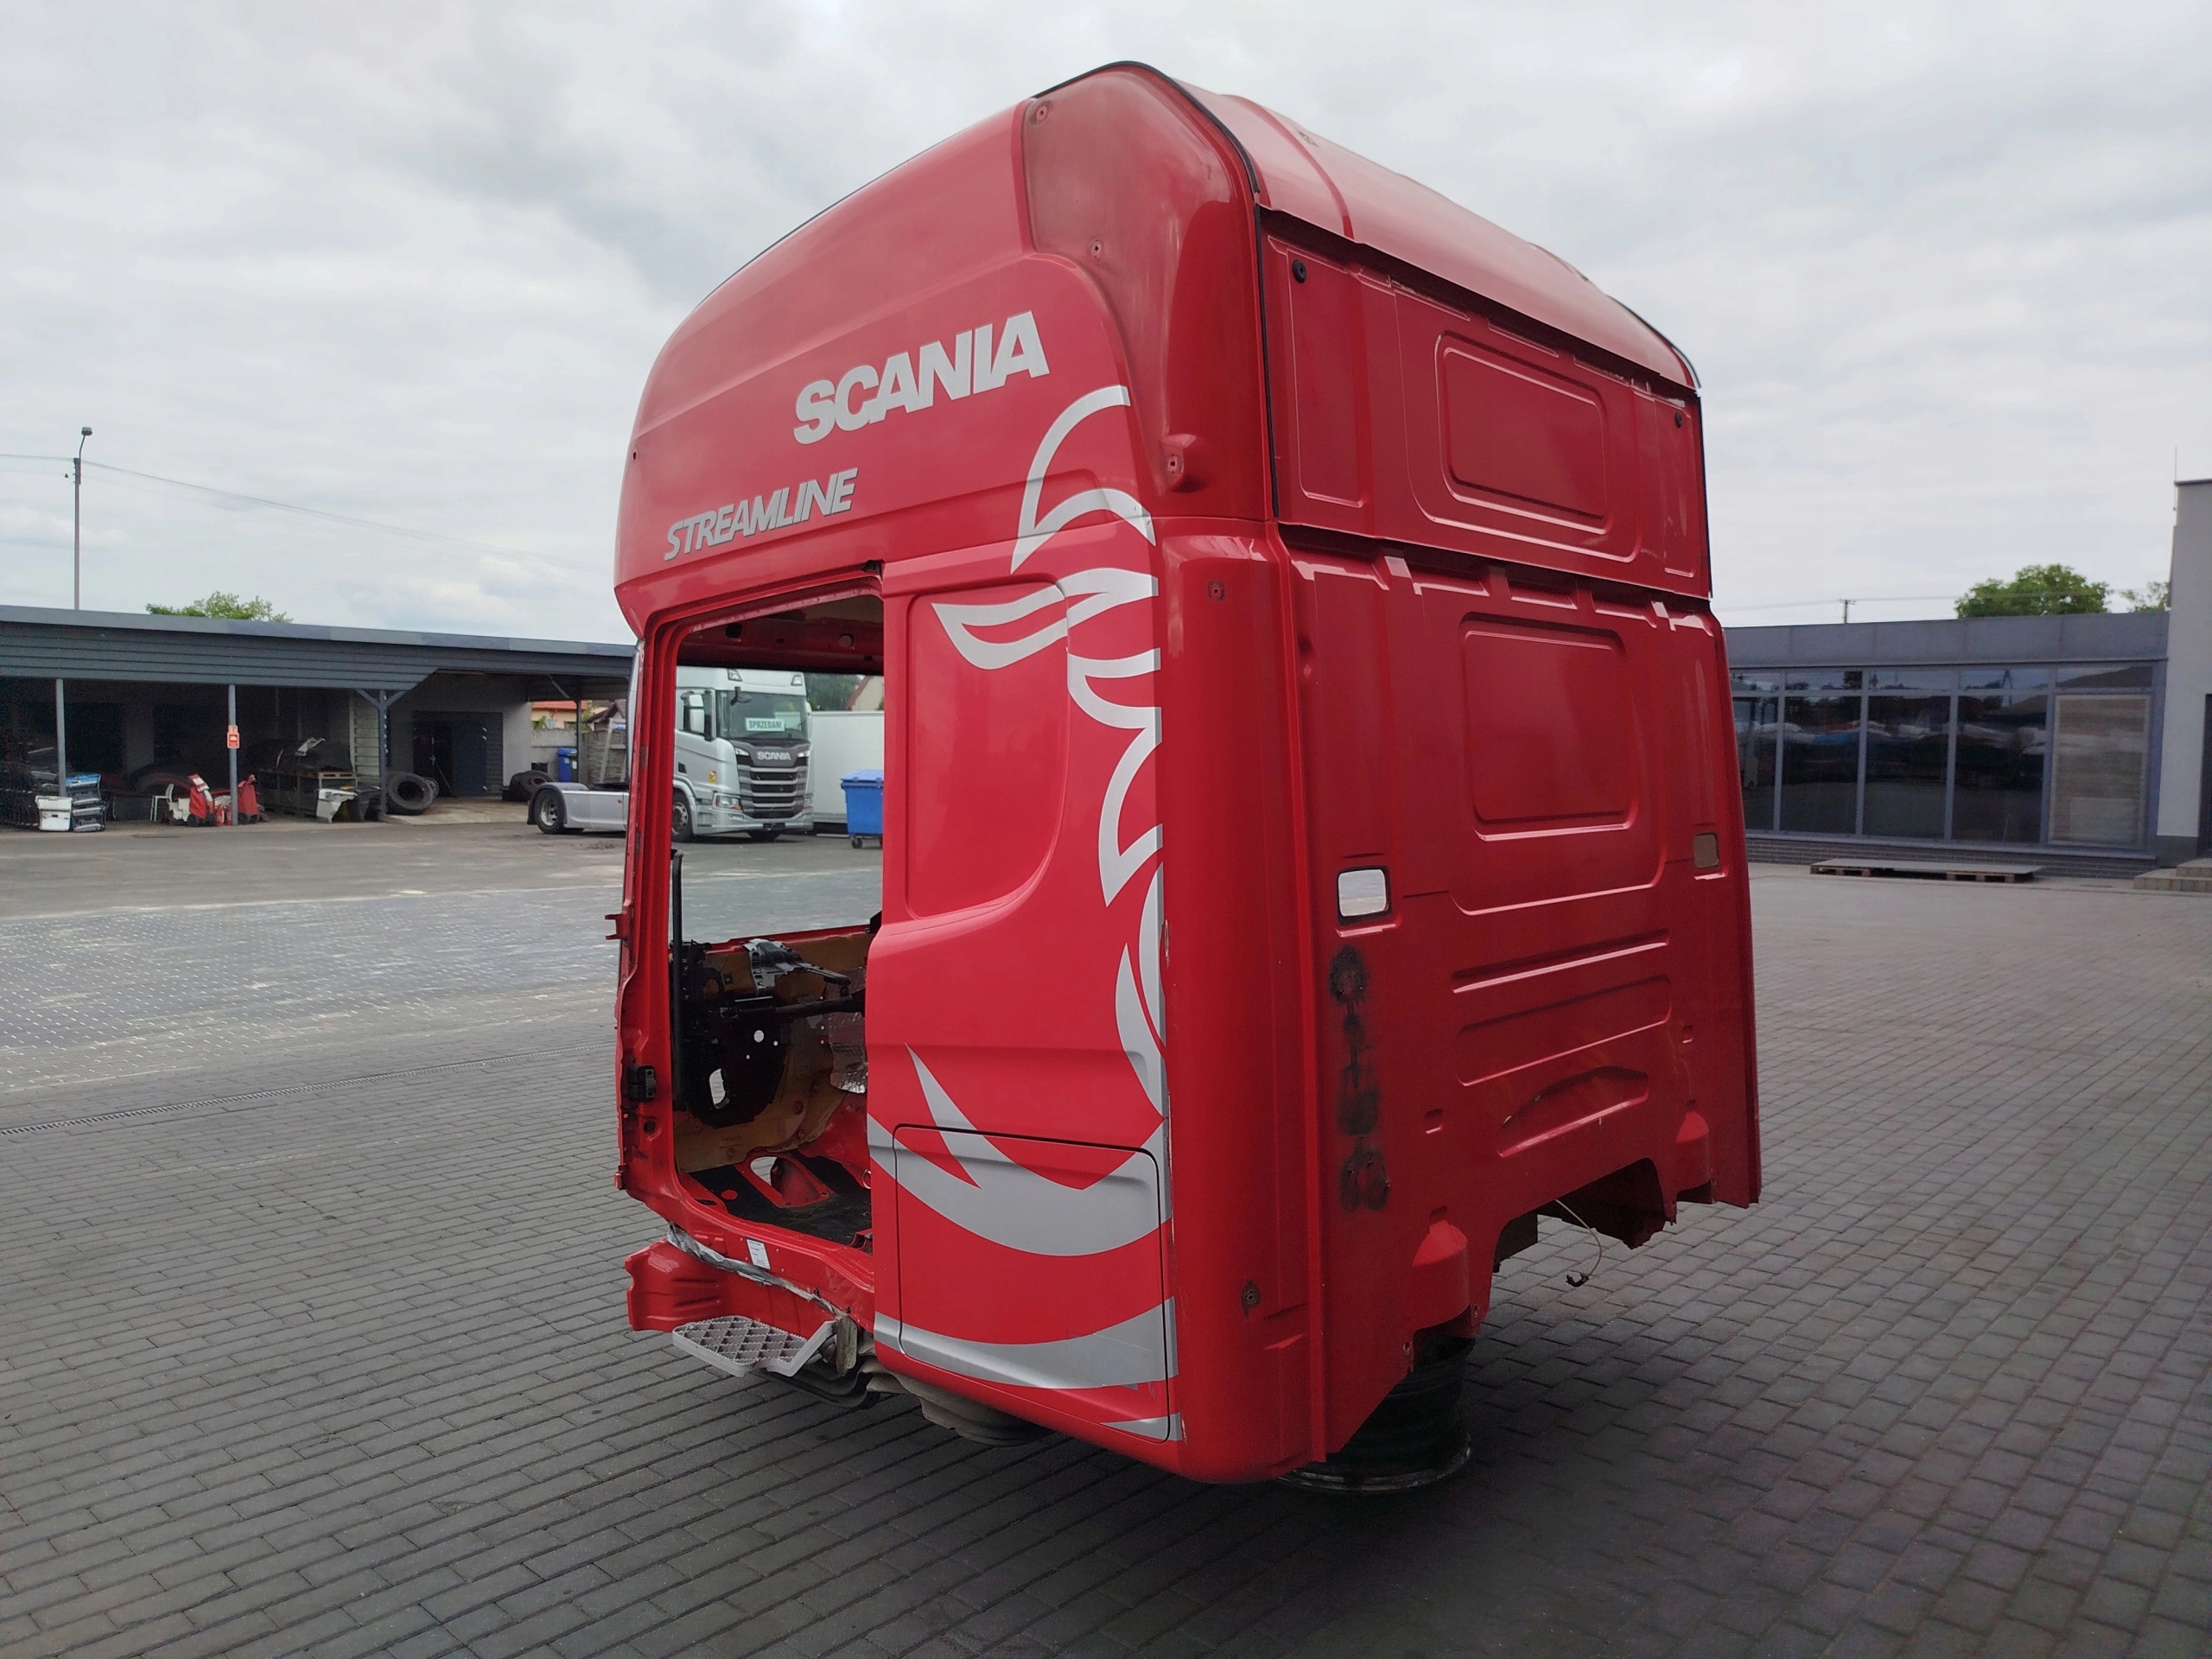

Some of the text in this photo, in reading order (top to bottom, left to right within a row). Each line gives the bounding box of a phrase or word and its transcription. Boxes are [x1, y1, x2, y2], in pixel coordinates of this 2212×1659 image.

[794, 311, 1050, 444] SCANIA
[664, 467, 858, 562] STREAMLINE
[748, 721, 783, 729] SPRZEDAM
[757, 751, 791, 760] SCANIA
